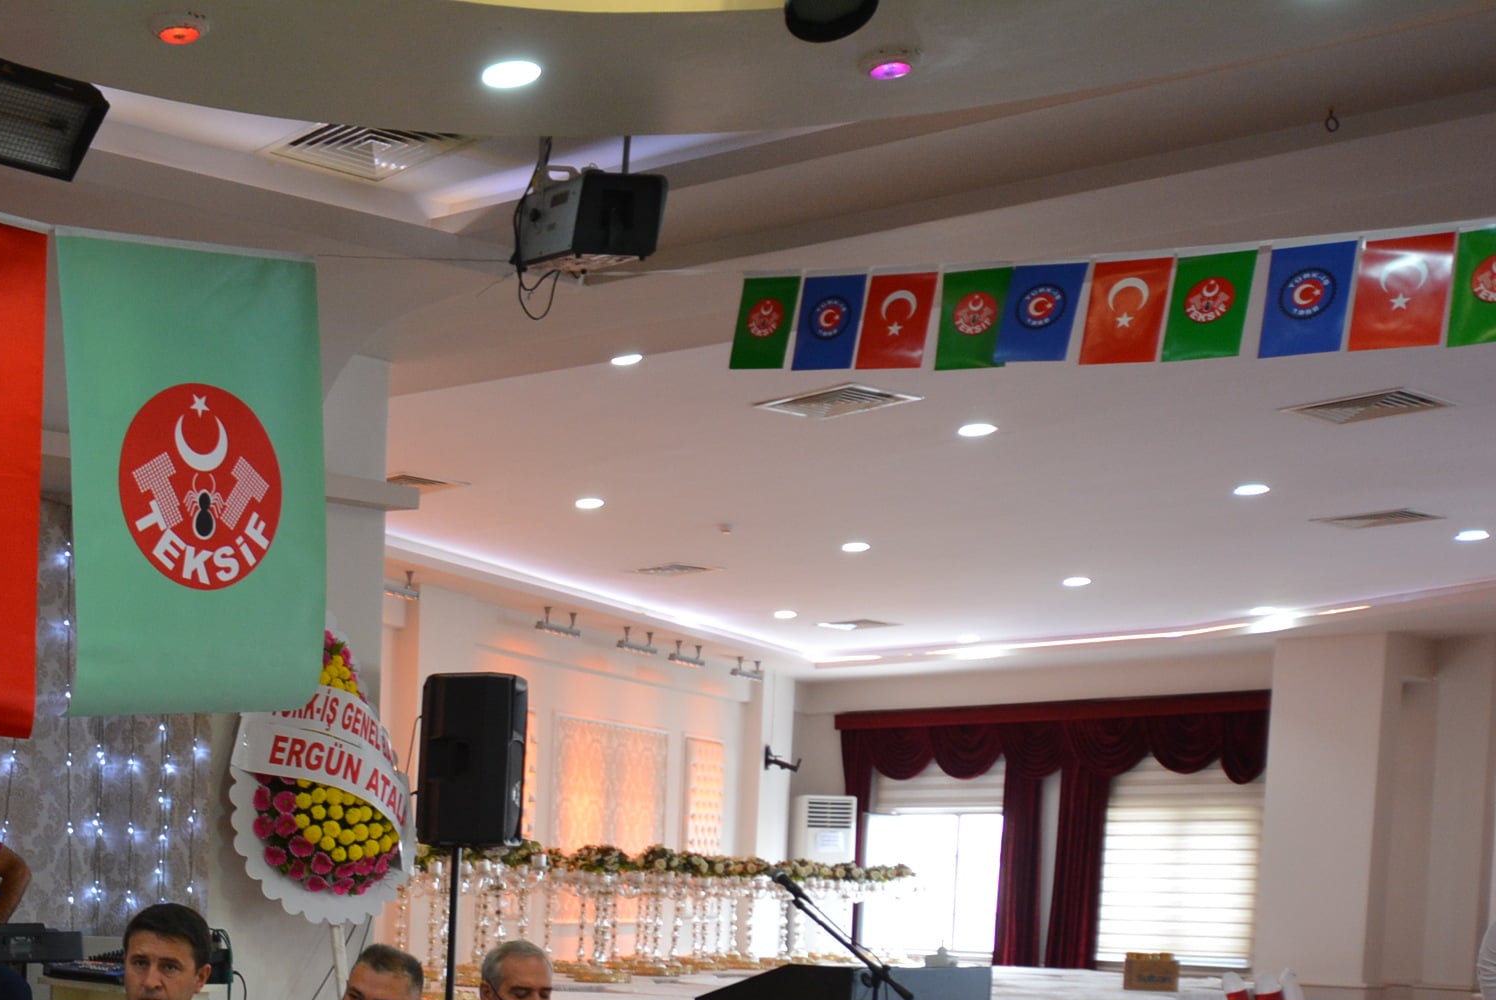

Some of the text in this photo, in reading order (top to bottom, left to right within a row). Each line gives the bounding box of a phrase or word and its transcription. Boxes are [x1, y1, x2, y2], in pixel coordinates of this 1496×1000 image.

[135, 500, 271, 585] TEKSİF
[342, 702, 381, 751] GENEL
[269, 735, 362, 784] ERGÜN
